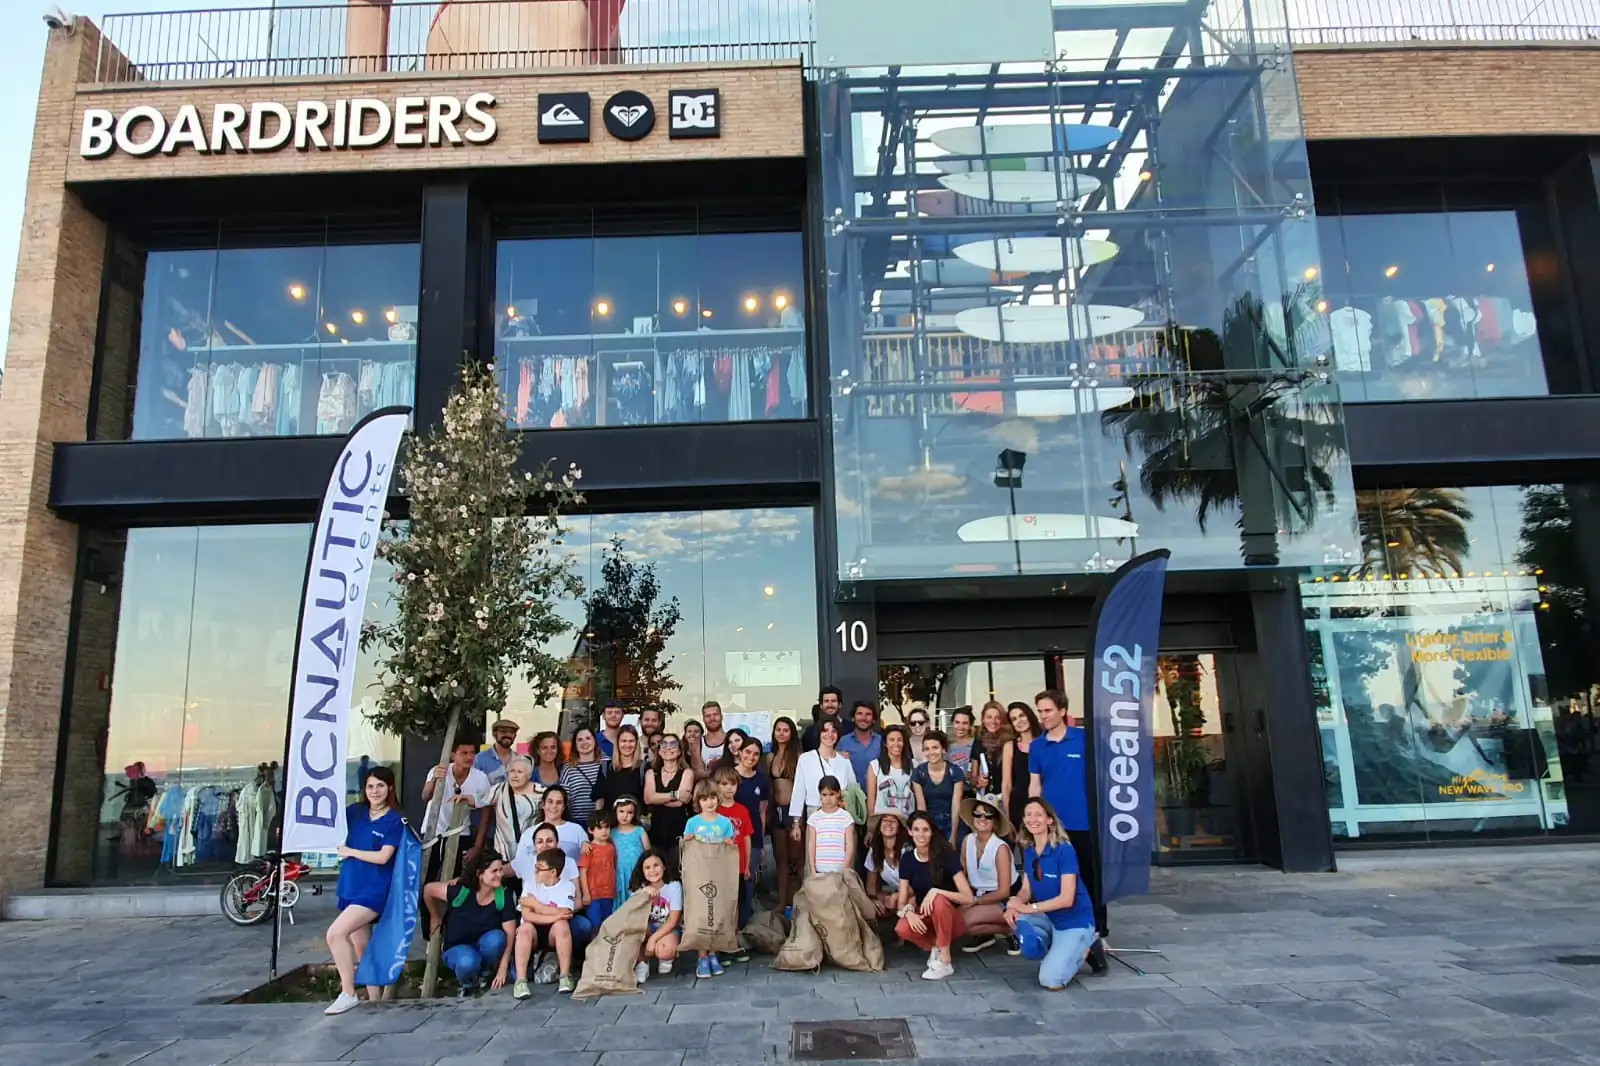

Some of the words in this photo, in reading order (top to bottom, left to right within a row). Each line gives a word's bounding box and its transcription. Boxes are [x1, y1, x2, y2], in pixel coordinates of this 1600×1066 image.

[79, 92, 498, 160] BOARDRIDERS
[349, 462, 387, 602] events
[295, 449, 373, 829] BCNAUTIC
[835, 620, 868, 652] 10
[1451, 647, 1513, 661] Flexible
[1102, 643, 1142, 842] ocean52
[1438, 784, 1464, 795] NEW
